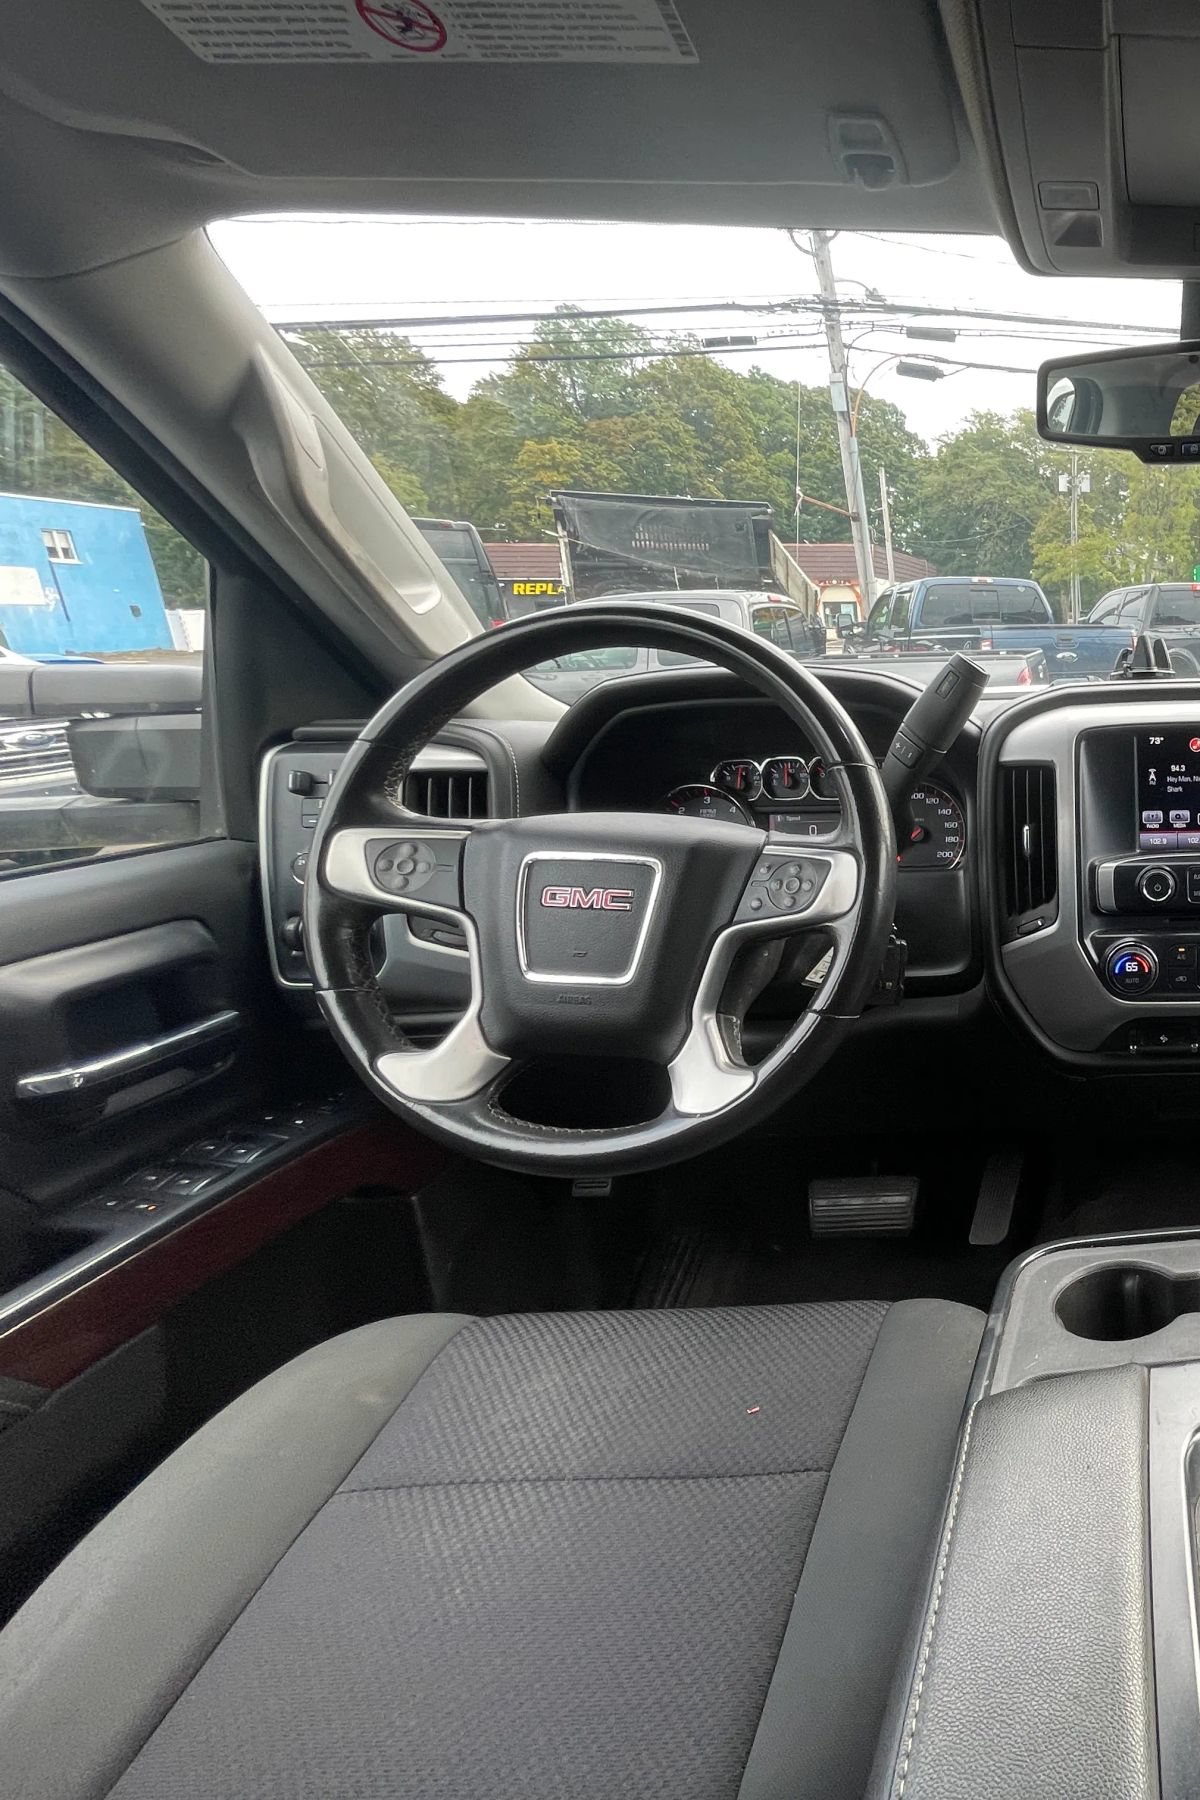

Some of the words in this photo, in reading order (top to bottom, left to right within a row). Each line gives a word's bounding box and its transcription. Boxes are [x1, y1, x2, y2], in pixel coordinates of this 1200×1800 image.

[703, 796, 711, 804] 3
[678, 806, 686, 815] 2
[944, 821, 958, 829] 160
[541, 885, 635, 912] GMC
[1125, 962, 1139, 972] 65
